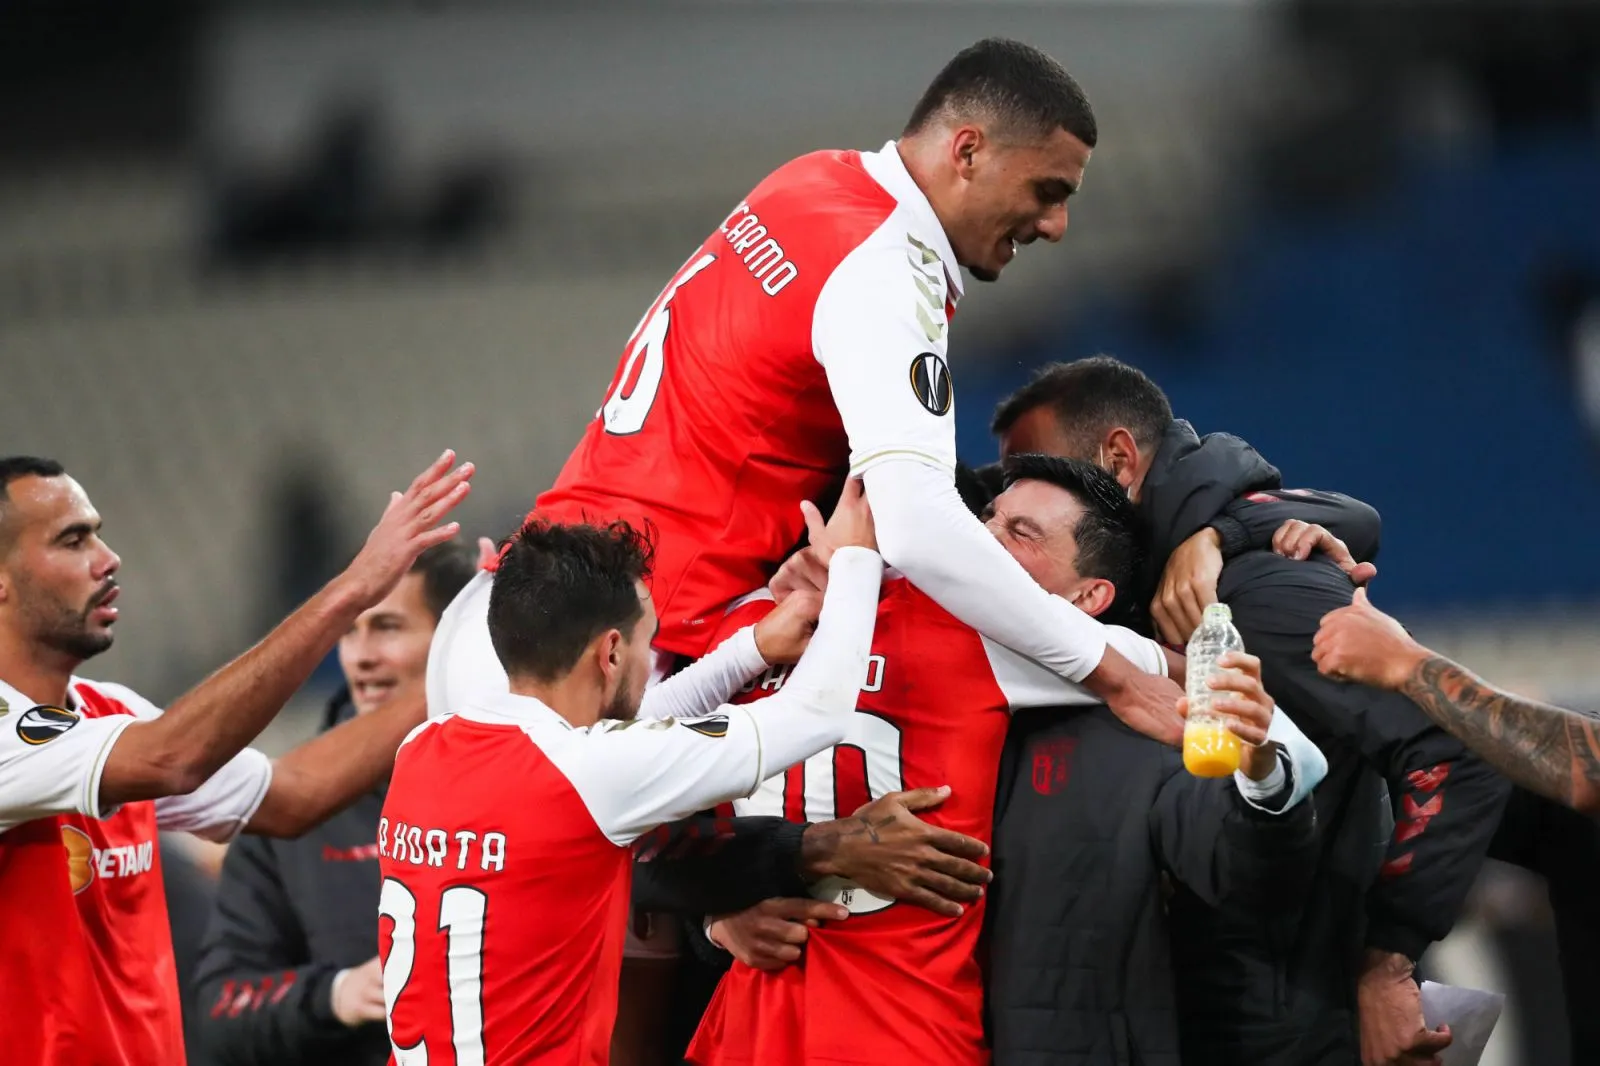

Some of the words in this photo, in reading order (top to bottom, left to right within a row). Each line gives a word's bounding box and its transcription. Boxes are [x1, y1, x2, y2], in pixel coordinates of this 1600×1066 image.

[719, 201, 799, 297] CARMO
[378, 817, 507, 872] R.HORTA
[378, 875, 489, 1066] 21
